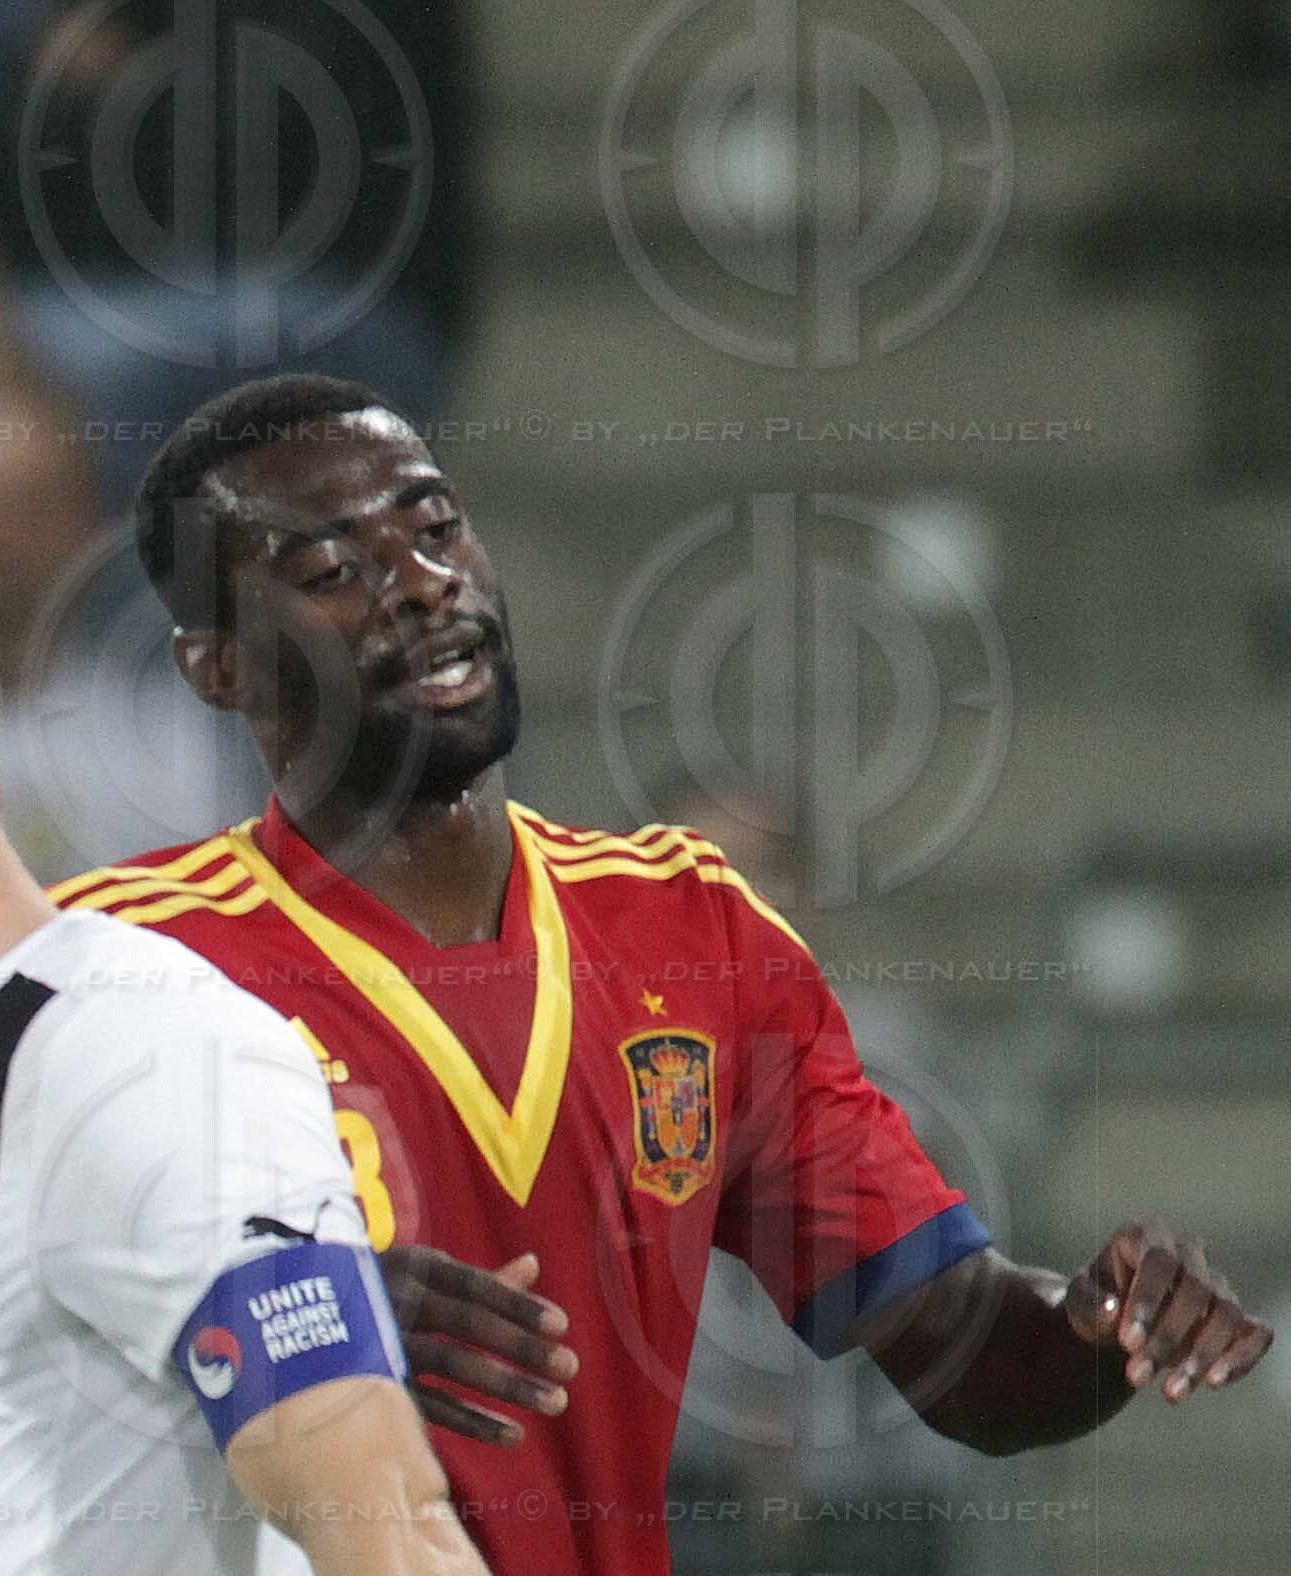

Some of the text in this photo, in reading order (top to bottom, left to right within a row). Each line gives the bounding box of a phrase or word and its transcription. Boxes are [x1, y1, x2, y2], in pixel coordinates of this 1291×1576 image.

[248, 1276, 336, 1320] UNITE
[261, 1301, 340, 1341] AGAINST
[265, 1320, 351, 1364] RACISM
